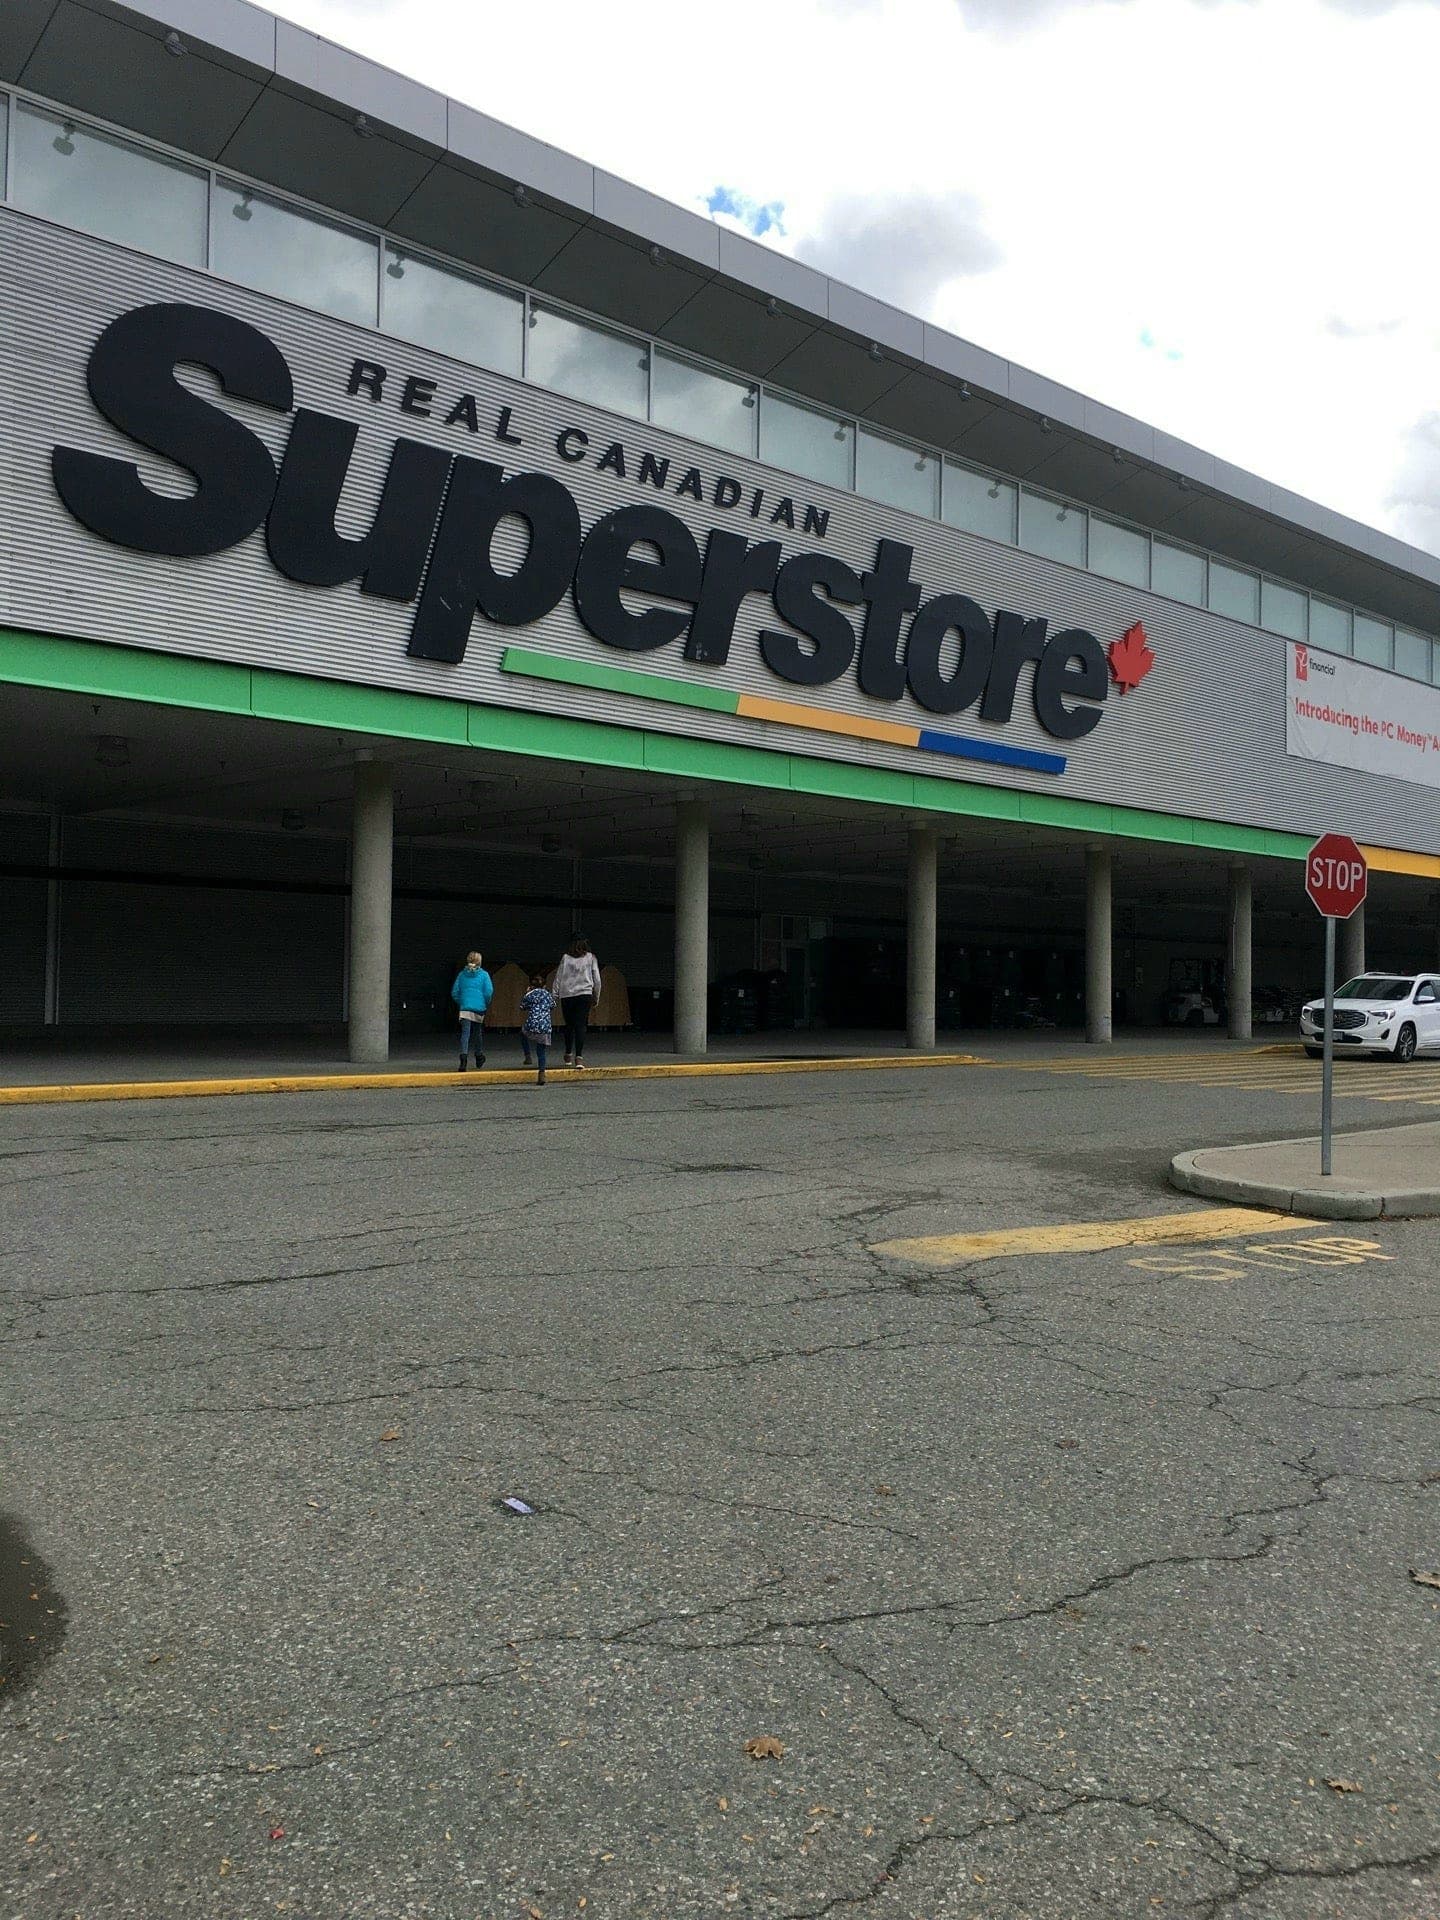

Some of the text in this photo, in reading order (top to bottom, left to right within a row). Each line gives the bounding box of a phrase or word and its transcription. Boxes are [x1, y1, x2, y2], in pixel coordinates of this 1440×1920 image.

[347, 358, 831, 539] REAL CANADIAN
[51, 303, 1109, 740] Superstore
[1309, 657, 1336, 676] financial
[1295, 697, 1359, 736] Introducing
[1361, 715, 1379, 735] the
[1381, 720, 1394, 739] PC
[1310, 856, 1364, 893] STOP
[1126, 1237, 1397, 1281] STOP
